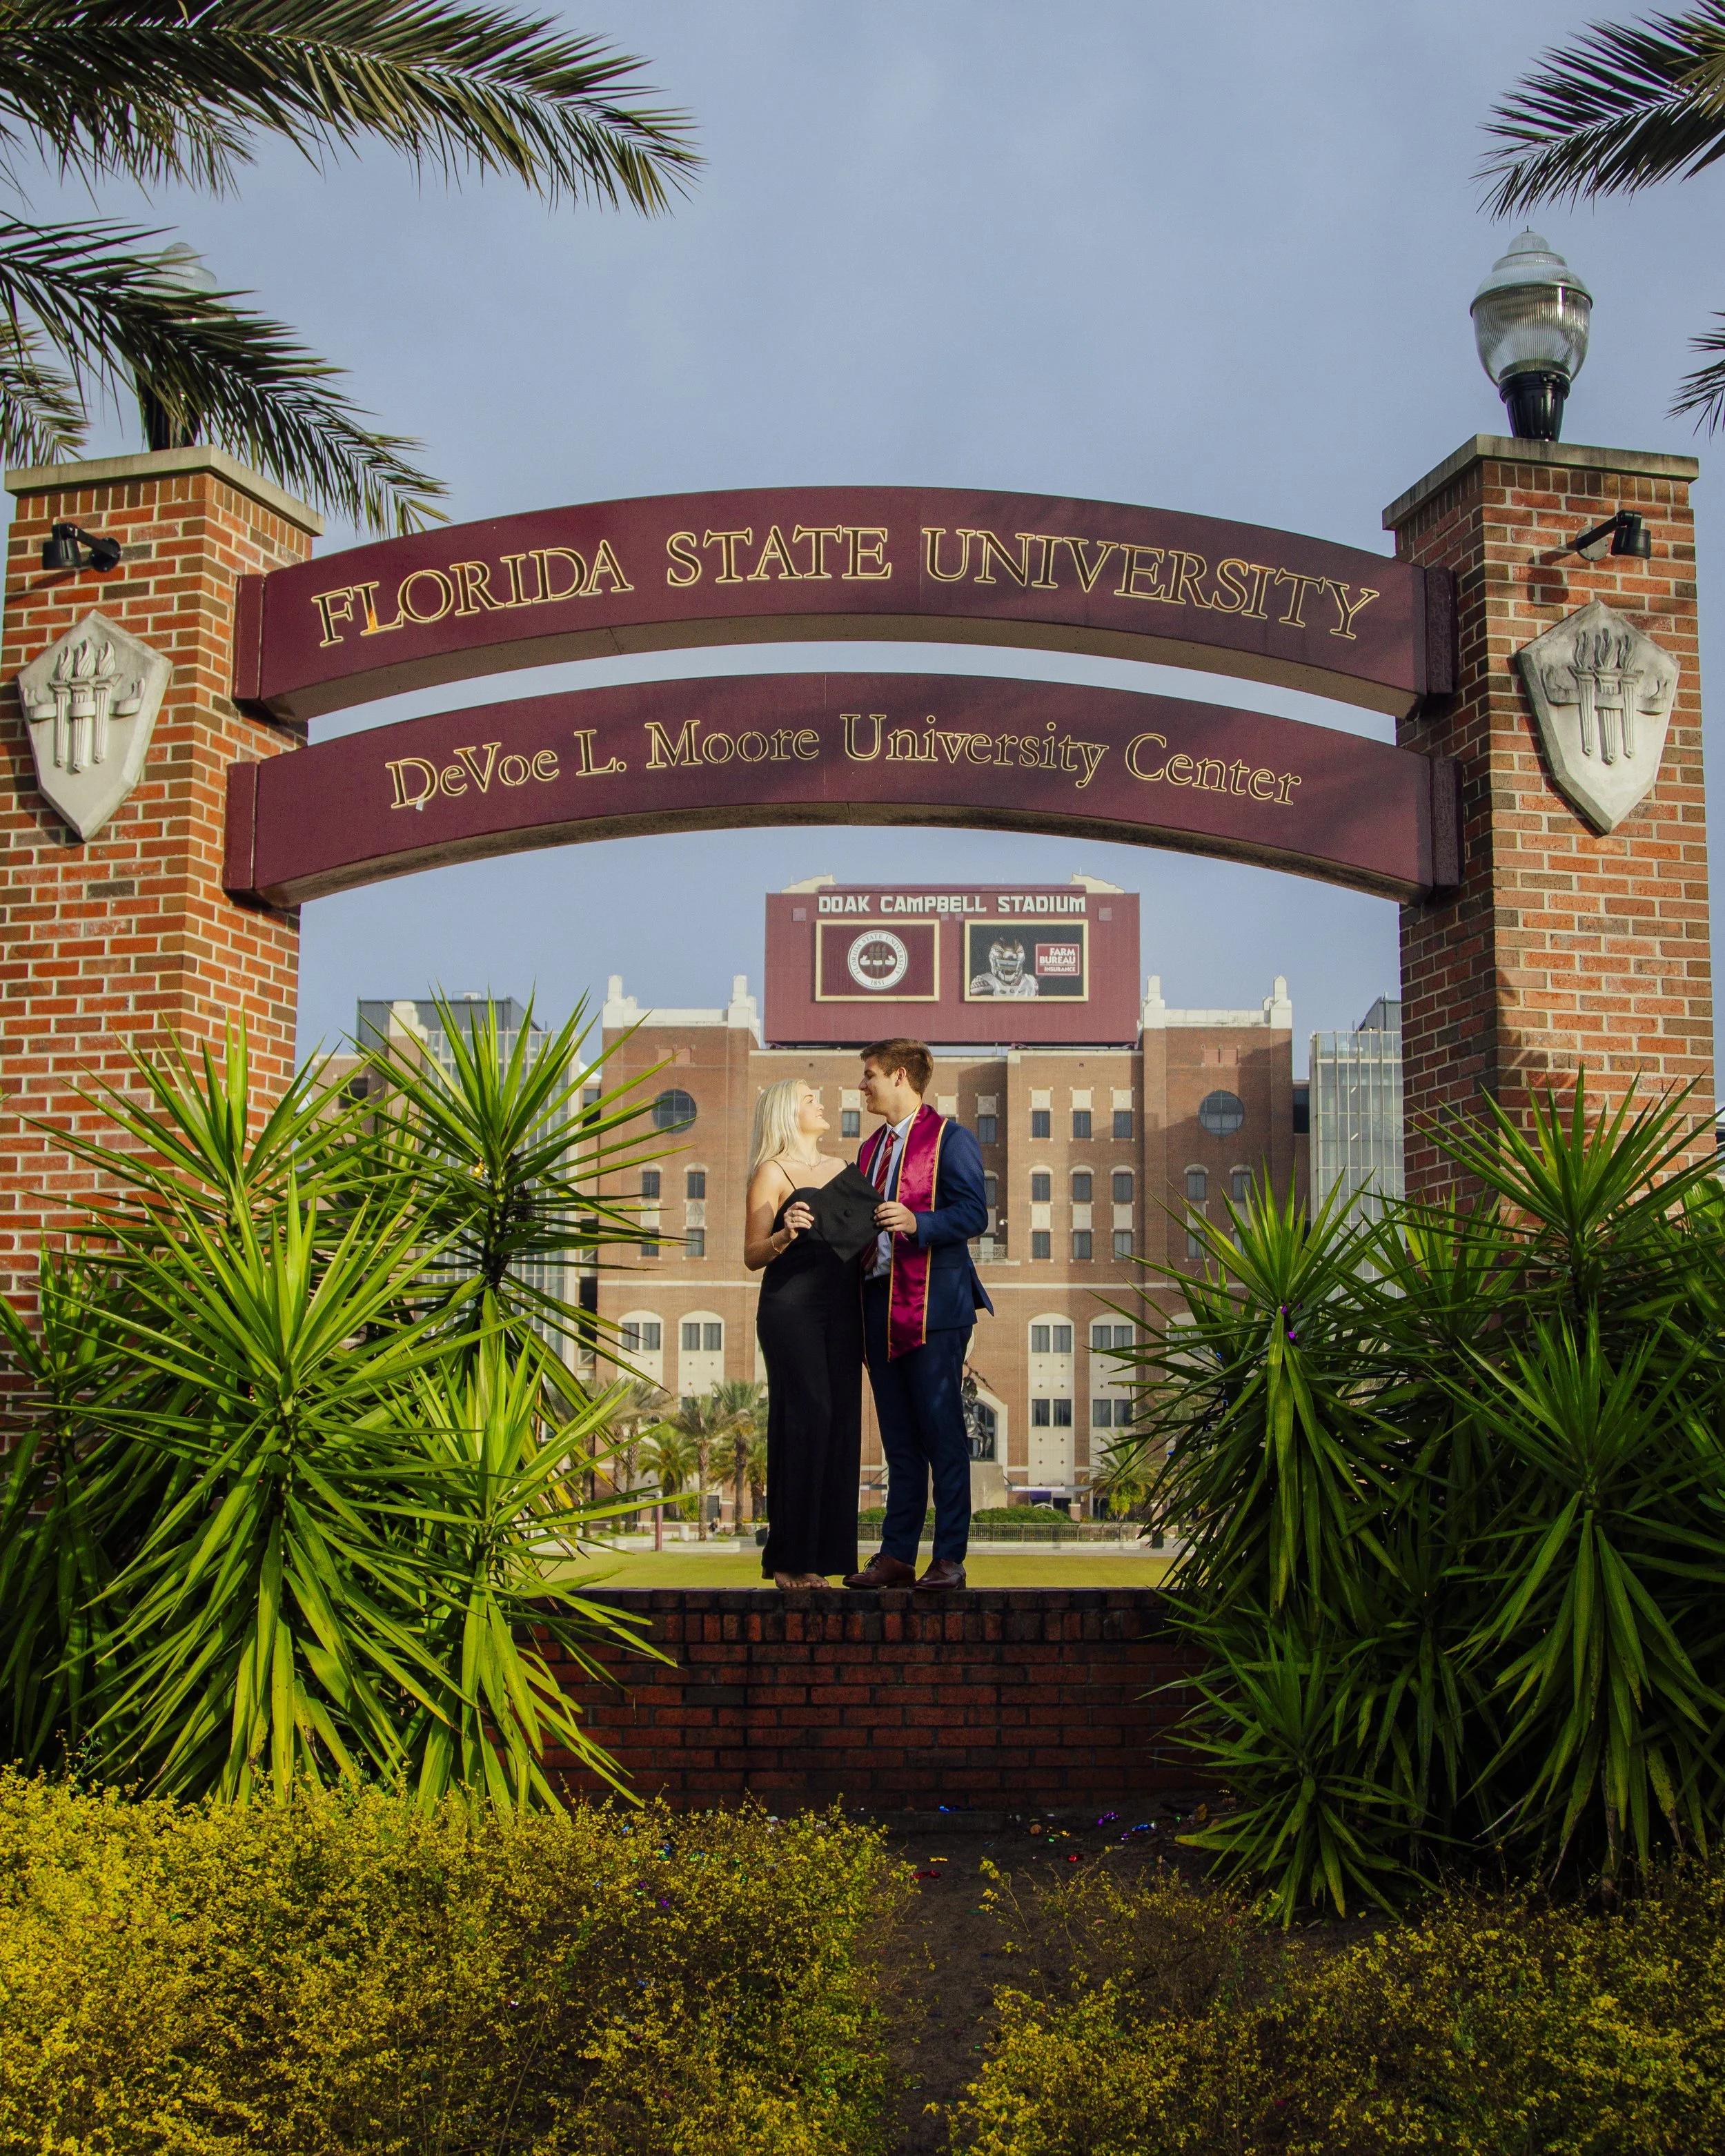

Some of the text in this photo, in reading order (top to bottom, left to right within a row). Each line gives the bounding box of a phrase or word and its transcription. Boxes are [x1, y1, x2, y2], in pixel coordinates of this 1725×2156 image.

[311, 524, 1380, 647] FLORIDA STATE UNIVERSITY
[385, 714, 1301, 809] DeVoe L. Moore University Center
[818, 896, 1086, 912] DOAK CAMPBELL STADIUM
[851, 934, 905, 975] FLORIDA STATE UNIVERSITY
[1039, 956, 1076, 964] BUREAU
[1049, 947, 1076, 956] FARM
